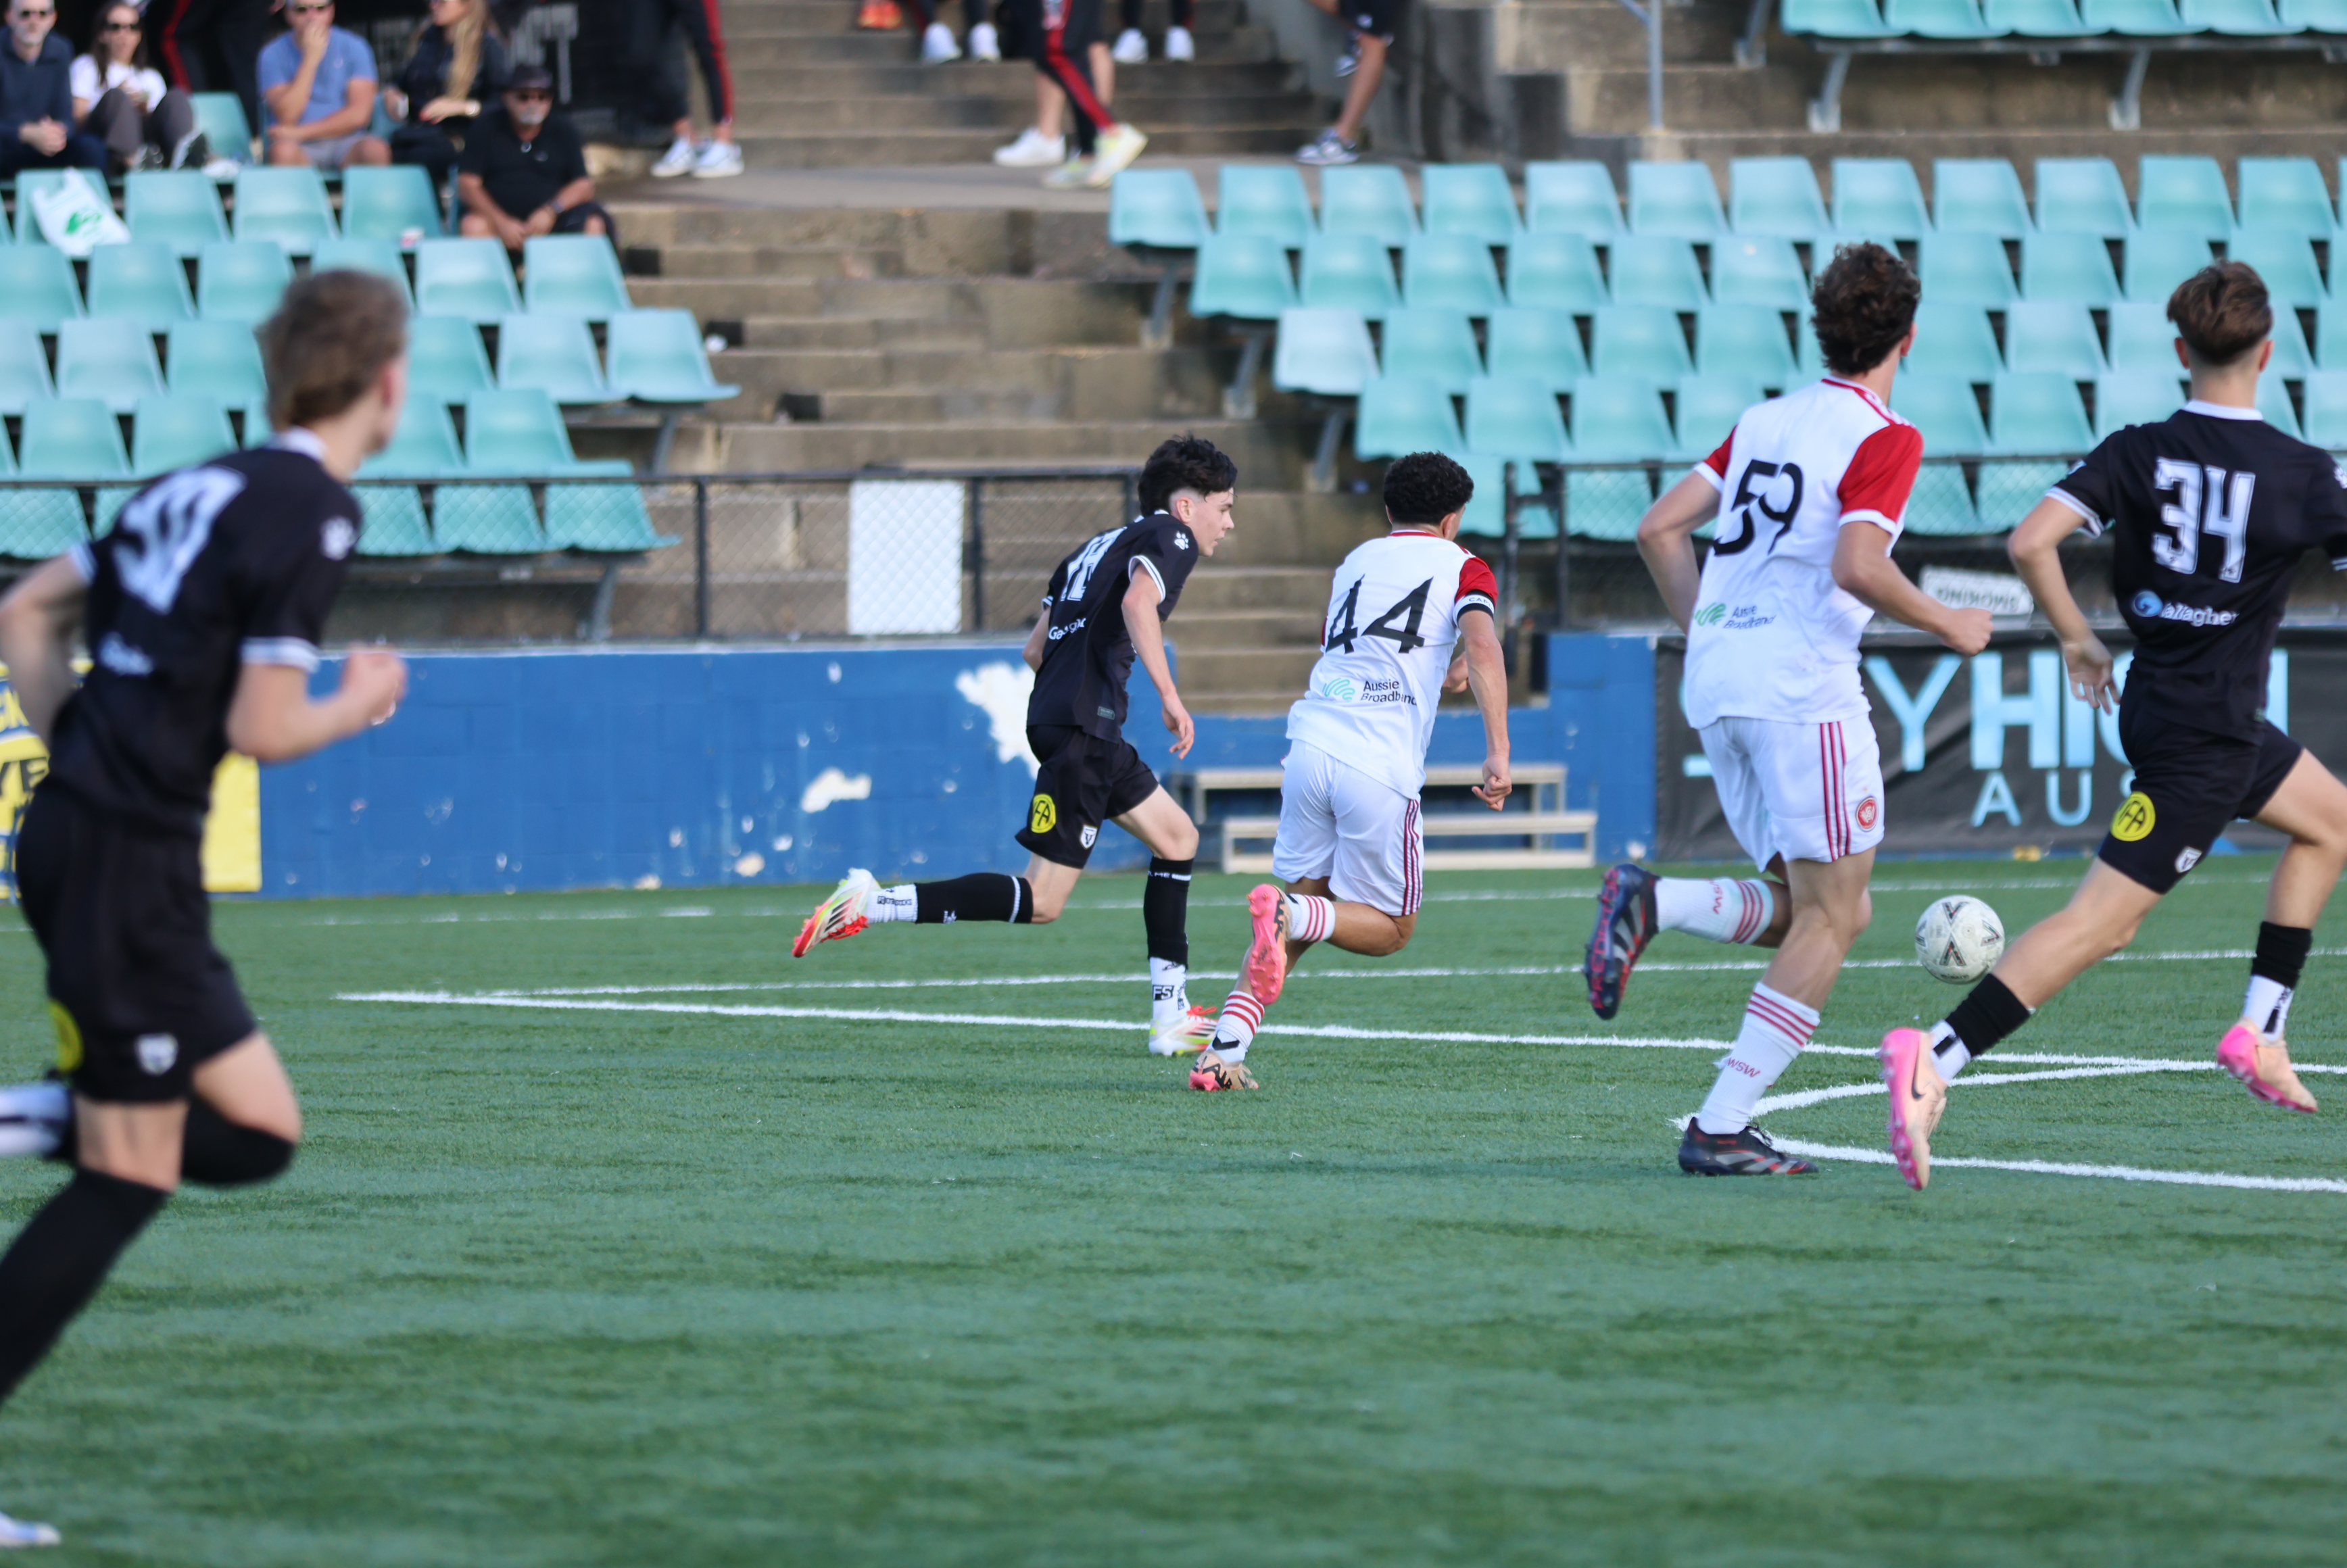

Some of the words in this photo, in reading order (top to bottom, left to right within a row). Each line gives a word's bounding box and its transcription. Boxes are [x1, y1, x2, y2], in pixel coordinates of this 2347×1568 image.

[1712, 459, 1804, 557] 59
[2152, 456, 2256, 583] 34
[1325, 573, 1434, 655] 44
[2159, 601, 2240, 627] allagher
[1363, 679, 1400, 692] Aussie
[1153, 986, 1173, 1000] FS
[1727, 1057, 1762, 1078] WSW
